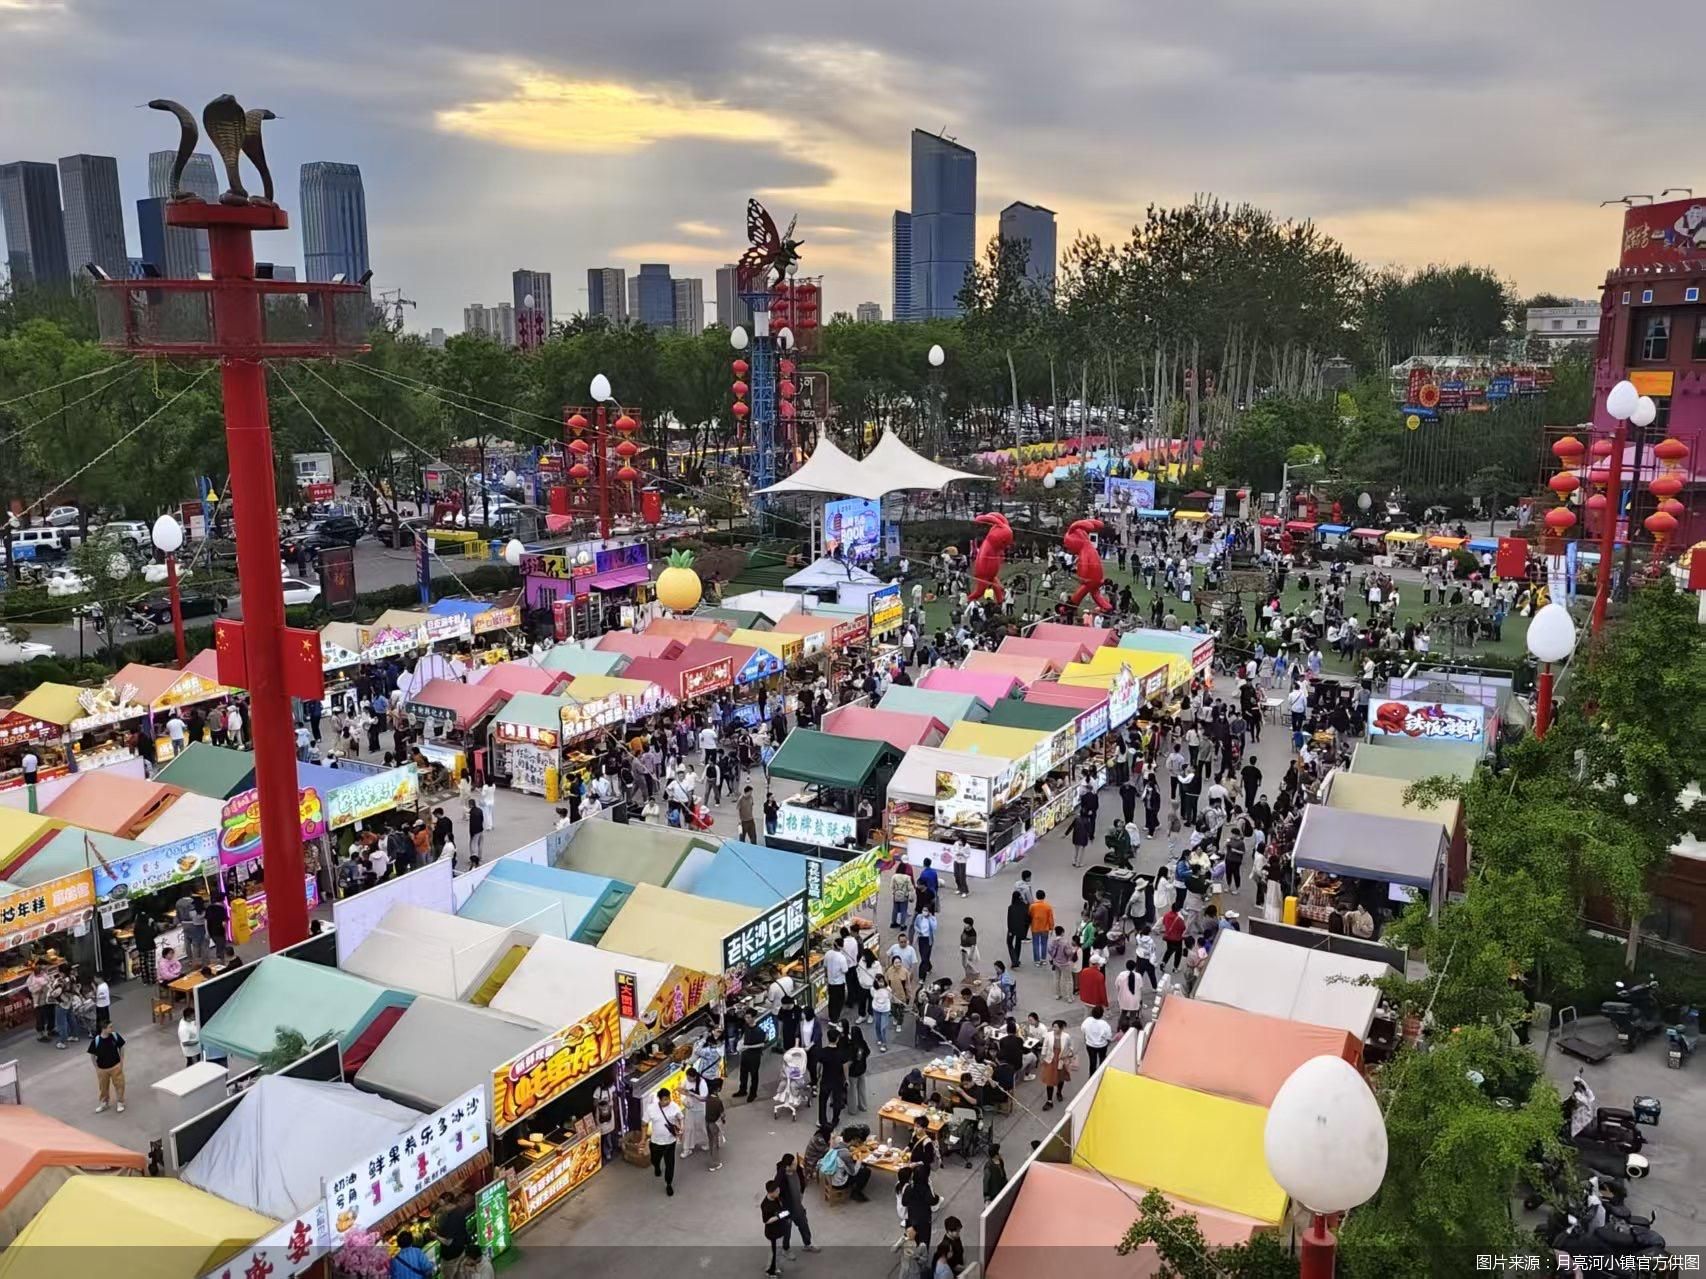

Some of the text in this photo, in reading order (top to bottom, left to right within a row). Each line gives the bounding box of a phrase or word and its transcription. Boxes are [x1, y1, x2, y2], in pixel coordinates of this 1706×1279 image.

[727, 898, 804, 966] 老长沙豆腐
[368, 1097, 480, 1180] 鲜果养乐多冰沙
[334, 1172, 357, 1194] 奶油
[336, 1188, 358, 1209] 号角
